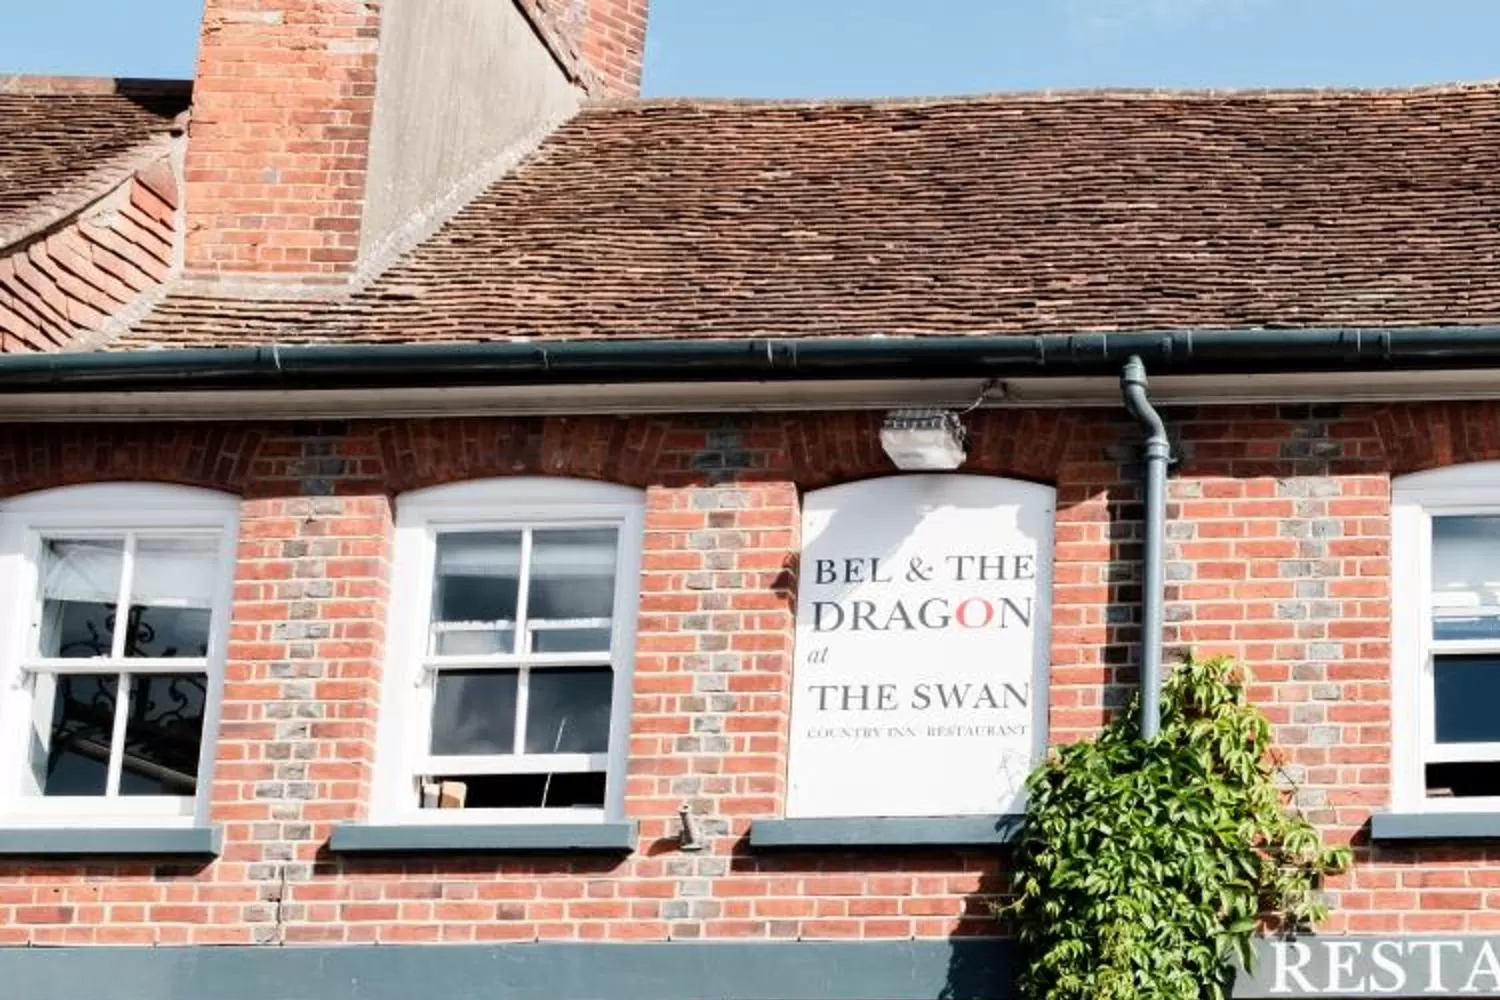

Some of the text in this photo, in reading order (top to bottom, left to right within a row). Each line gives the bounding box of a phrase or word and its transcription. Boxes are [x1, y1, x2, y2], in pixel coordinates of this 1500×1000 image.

[815, 554, 1035, 585] BEL & THE
[812, 597, 1032, 632] DRAGON
[807, 646, 829, 665] at
[808, 682, 1029, 711] THE SWAN
[807, 726, 881, 739] COUNTRY
[927, 724, 1028, 738] RESTAURANT
